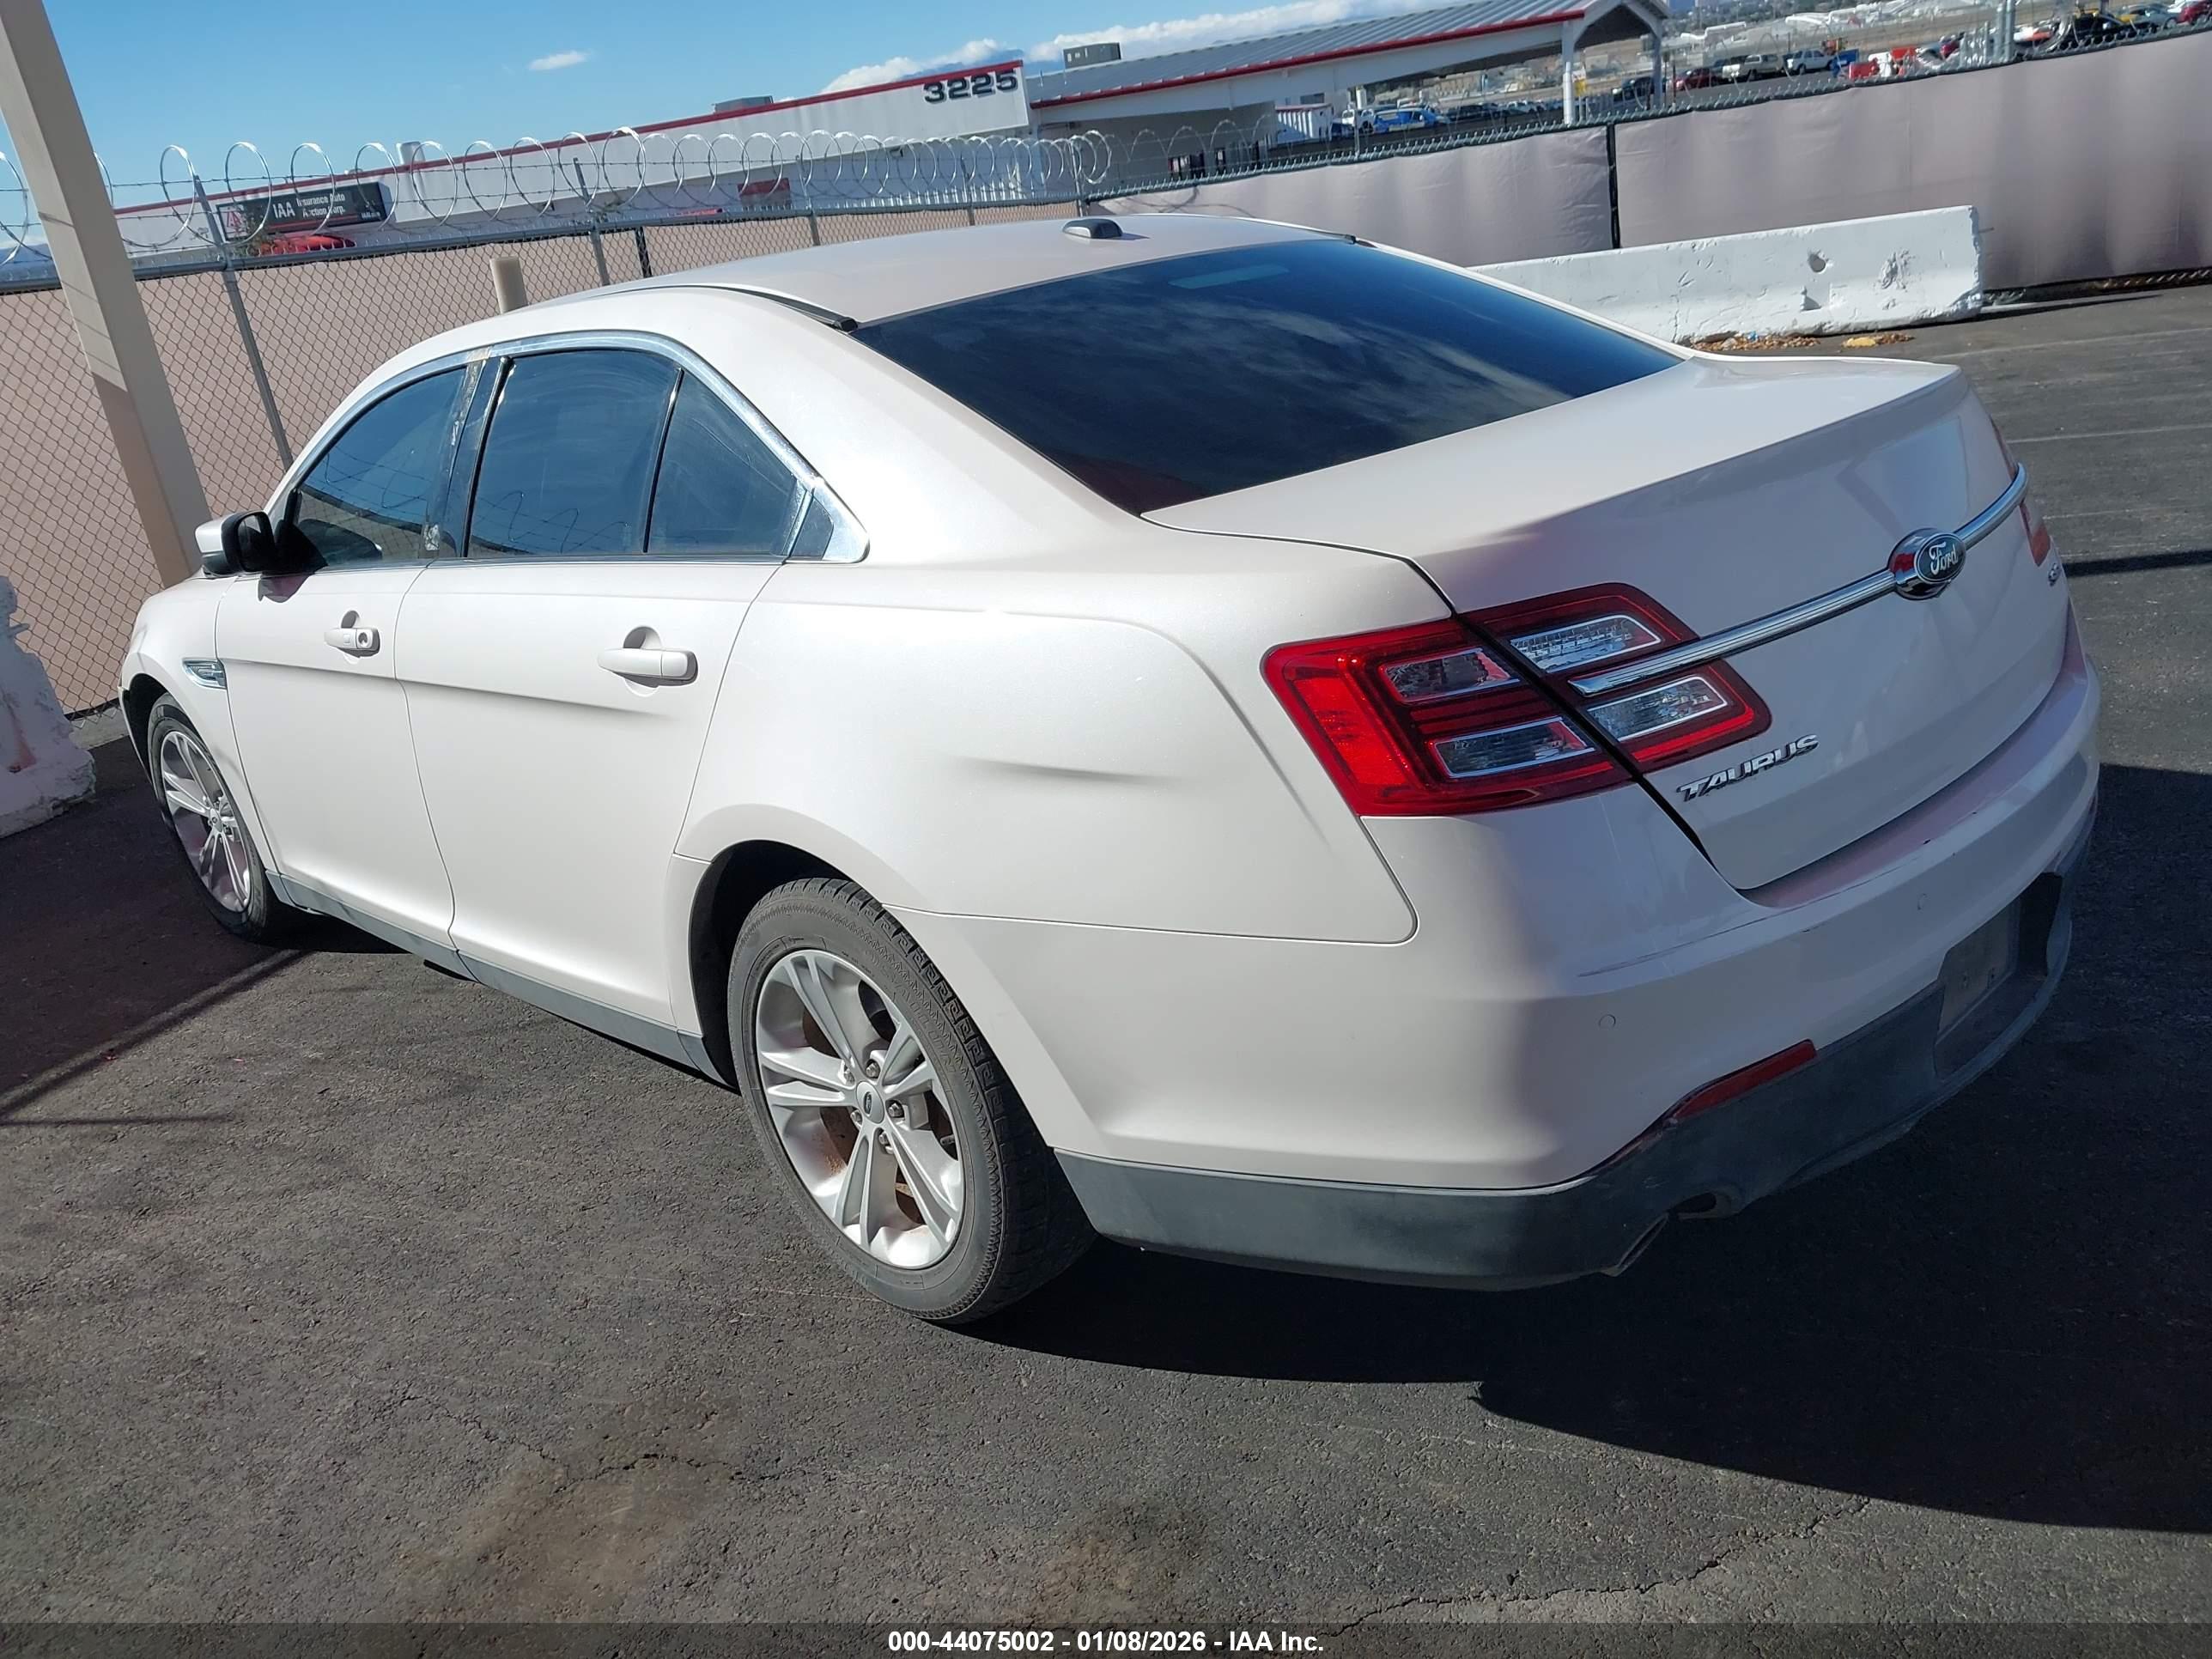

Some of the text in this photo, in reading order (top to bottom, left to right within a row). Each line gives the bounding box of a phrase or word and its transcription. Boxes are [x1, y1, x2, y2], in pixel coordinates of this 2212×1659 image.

[923, 68, 1018, 104] 3225
[272, 201, 296, 219] IAA
[1929, 541, 1960, 575] Ford
[1676, 733, 1820, 802] TAURUS
